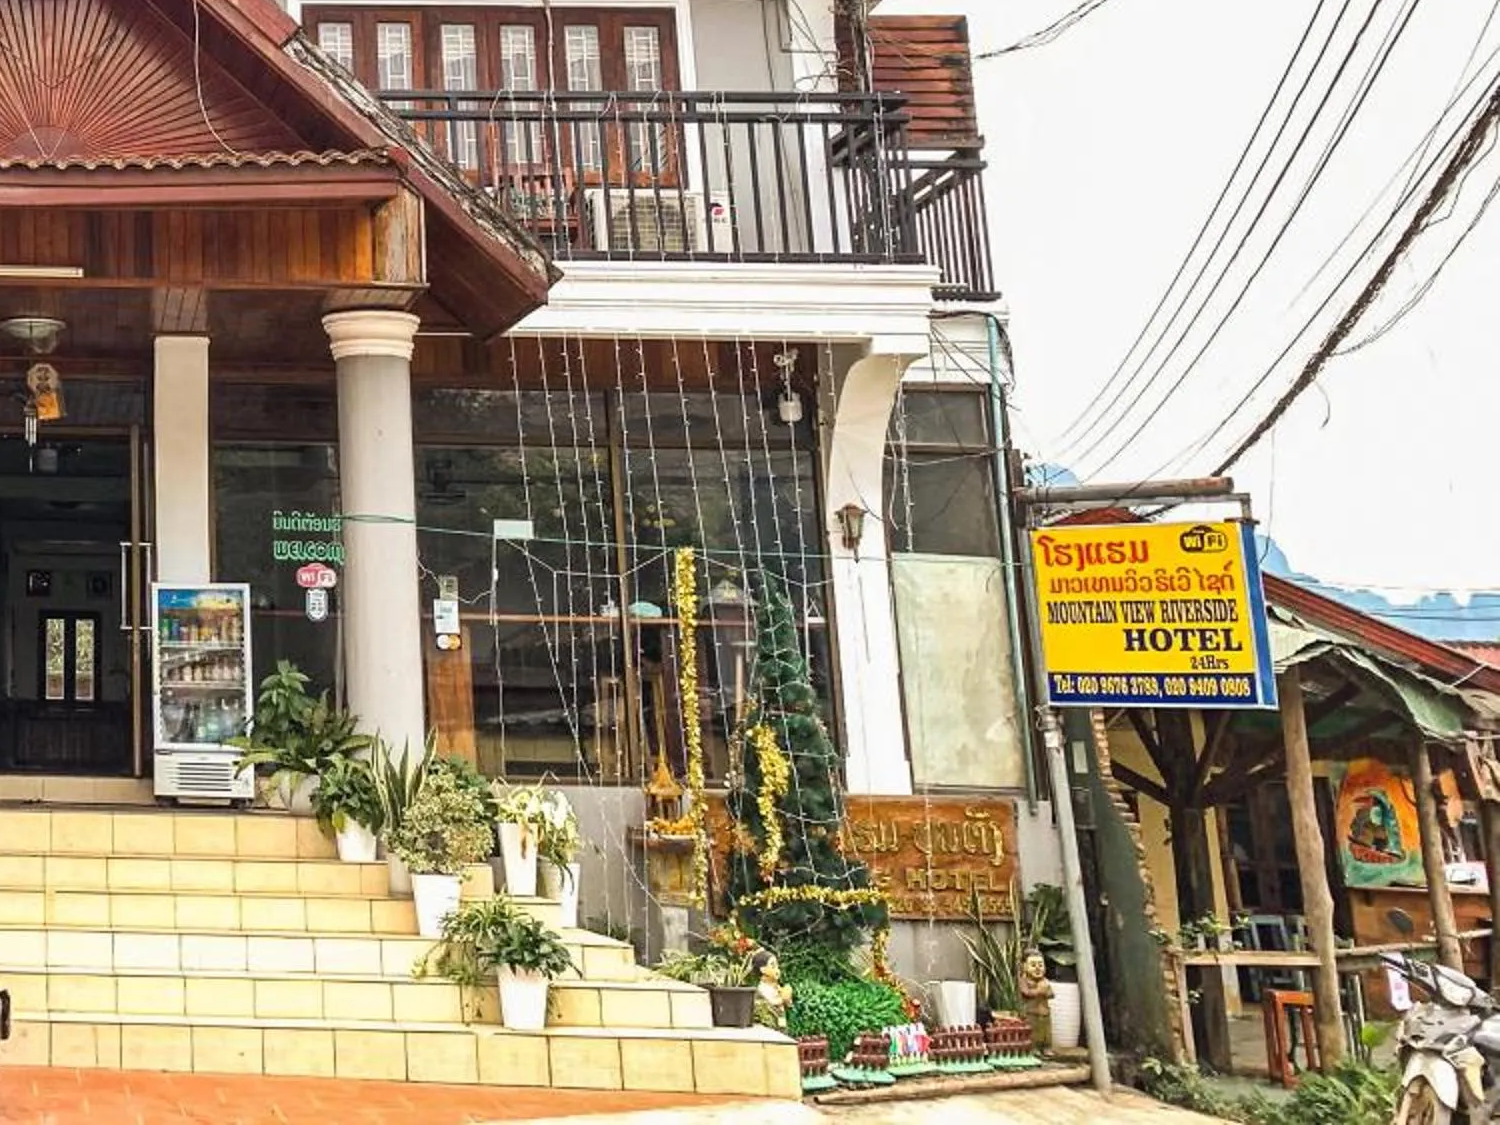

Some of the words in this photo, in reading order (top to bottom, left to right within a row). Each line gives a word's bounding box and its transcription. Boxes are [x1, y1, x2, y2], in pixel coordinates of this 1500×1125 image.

[273, 540, 344, 565] WELCOM
[1047, 601, 1118, 624] MOUNTAIN
[1120, 600, 1155, 623] VIEW
[1160, 599, 1238, 623] RIVERSIDE
[1123, 628, 1243, 652] HOTEL
[1054, 675, 1074, 694] Tel:
[1078, 676, 1098, 695] 020
[1164, 677, 1186, 696] 020
[905, 866, 1008, 891] HOTEL
